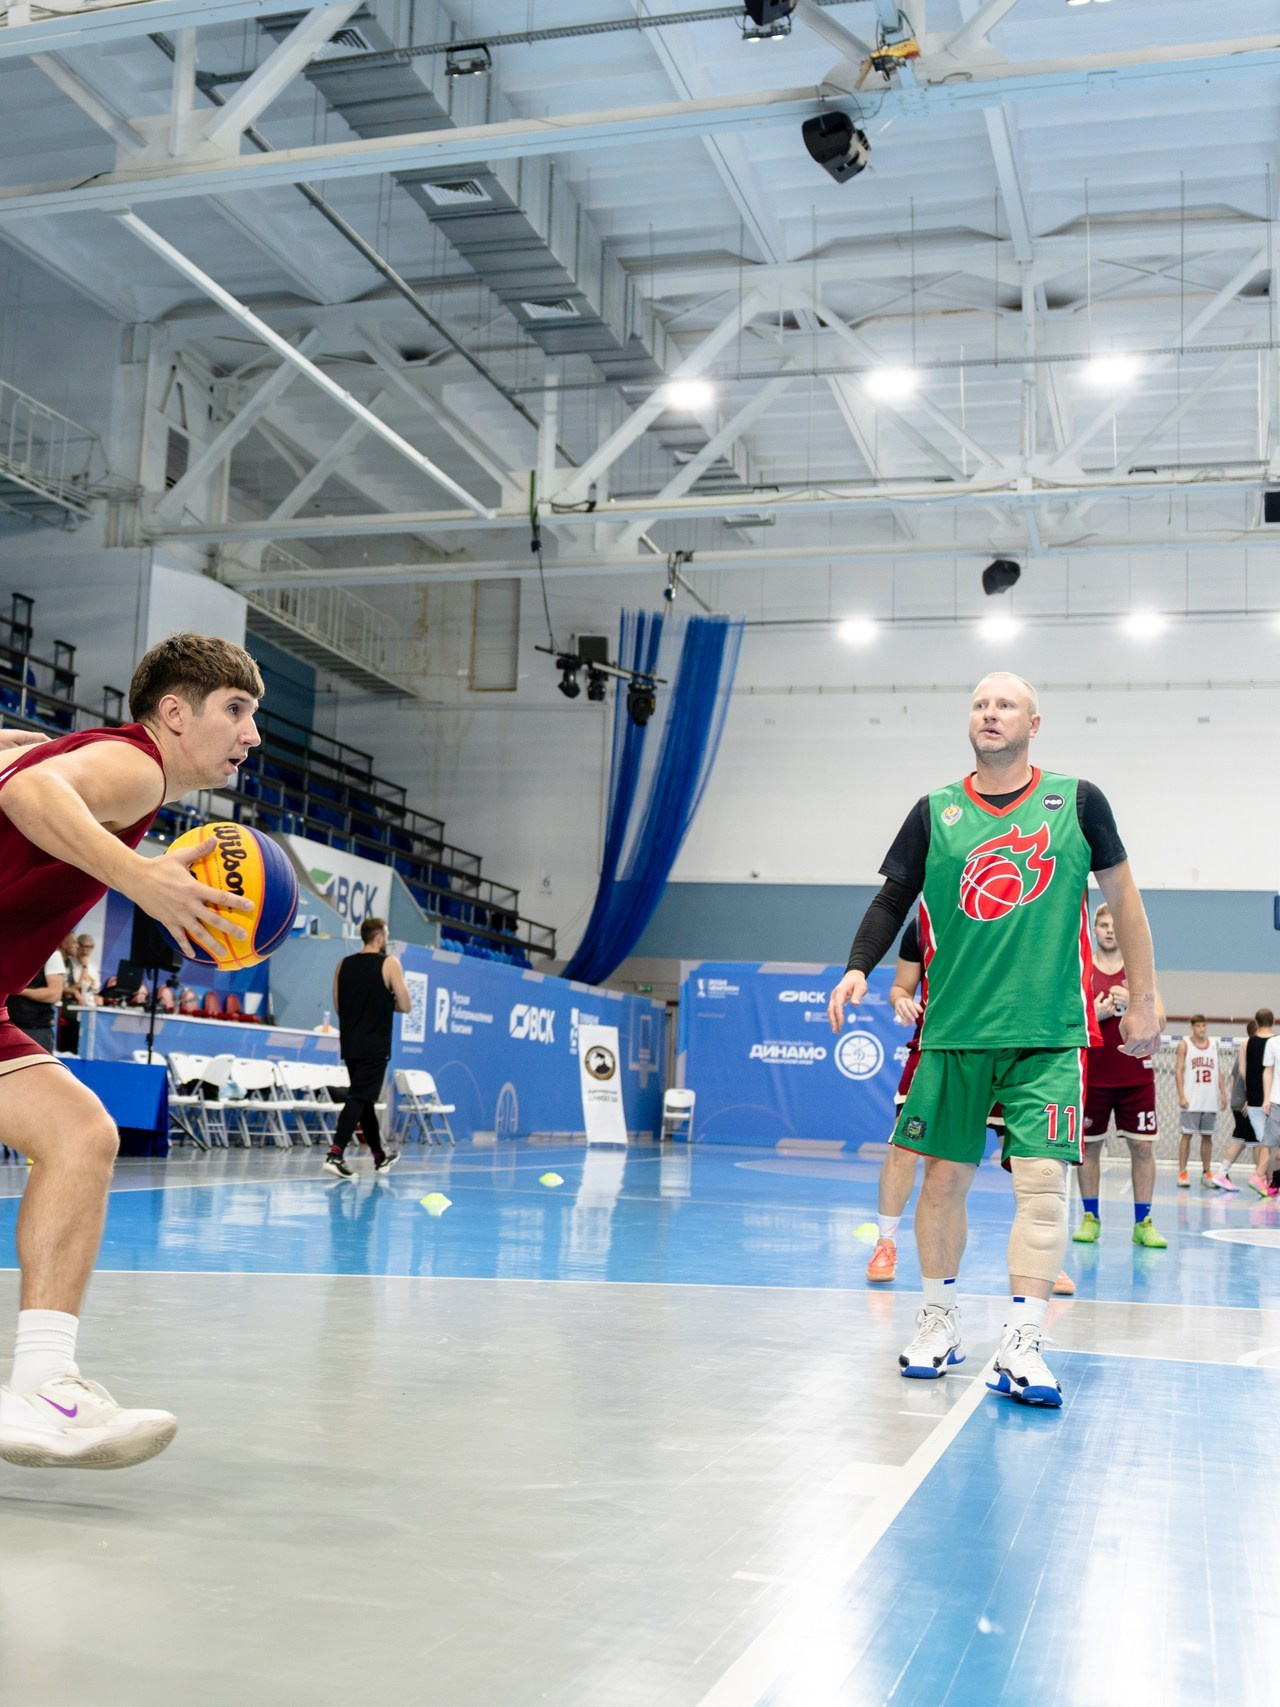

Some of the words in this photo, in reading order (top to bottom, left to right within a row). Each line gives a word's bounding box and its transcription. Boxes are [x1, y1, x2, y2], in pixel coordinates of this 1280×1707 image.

[336, 876, 379, 926] ВСК
[799, 990, 826, 1004] ВСК
[529, 1006, 556, 1045] ВСК
[749, 1044, 827, 1060] ДИНАМО
[1196, 1069, 1211, 1083] 12
[1043, 1103, 1076, 1143] 11
[1137, 1111, 1156, 1131] 13
